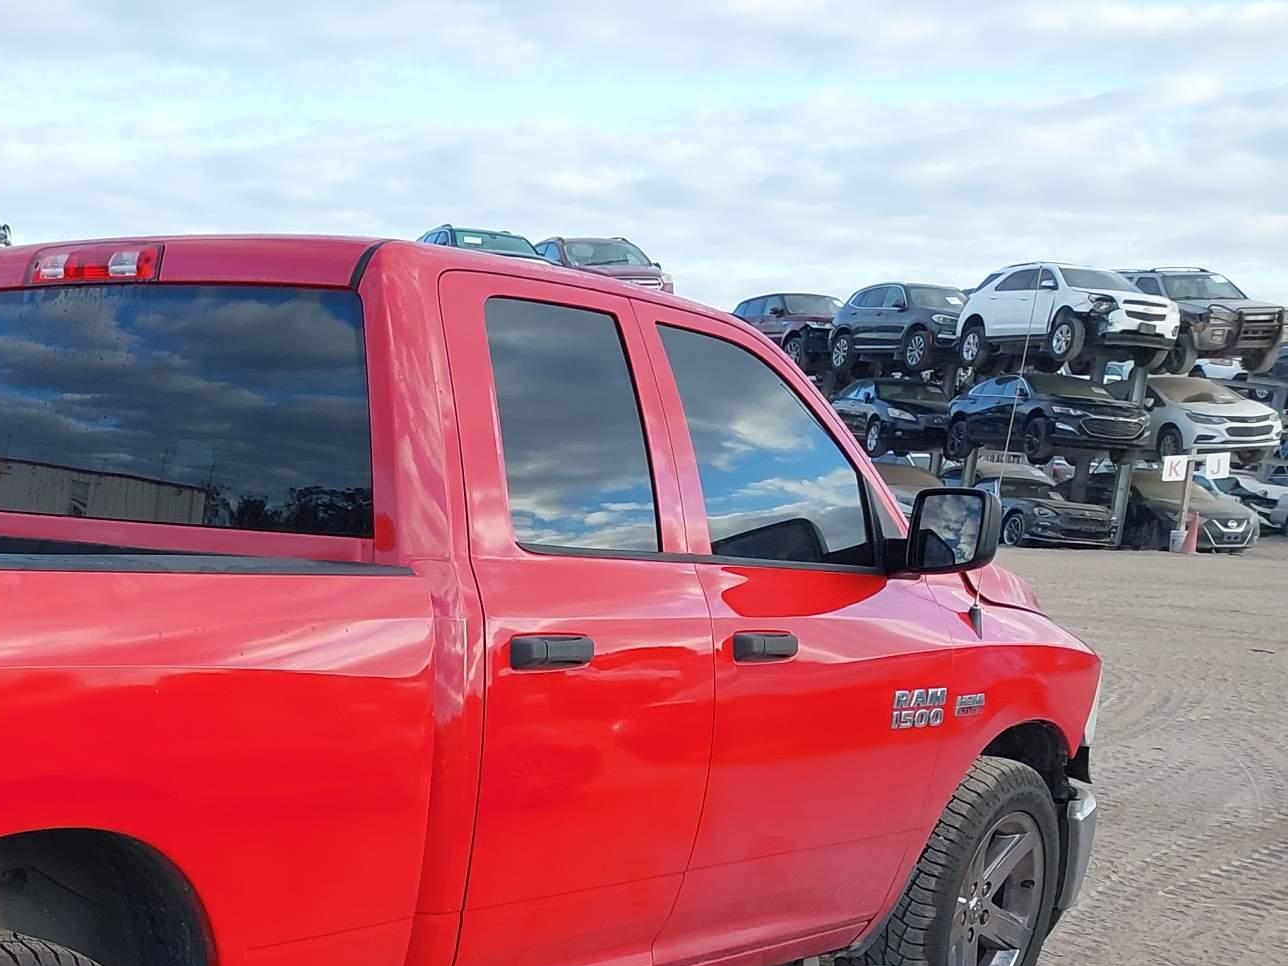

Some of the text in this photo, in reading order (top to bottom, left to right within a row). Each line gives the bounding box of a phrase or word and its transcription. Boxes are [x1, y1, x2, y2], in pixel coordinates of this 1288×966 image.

[1168, 460, 1182, 477] K
[1211, 458, 1222, 475] J
[894, 688, 947, 708] RAM
[892, 708, 944, 729] 1500
